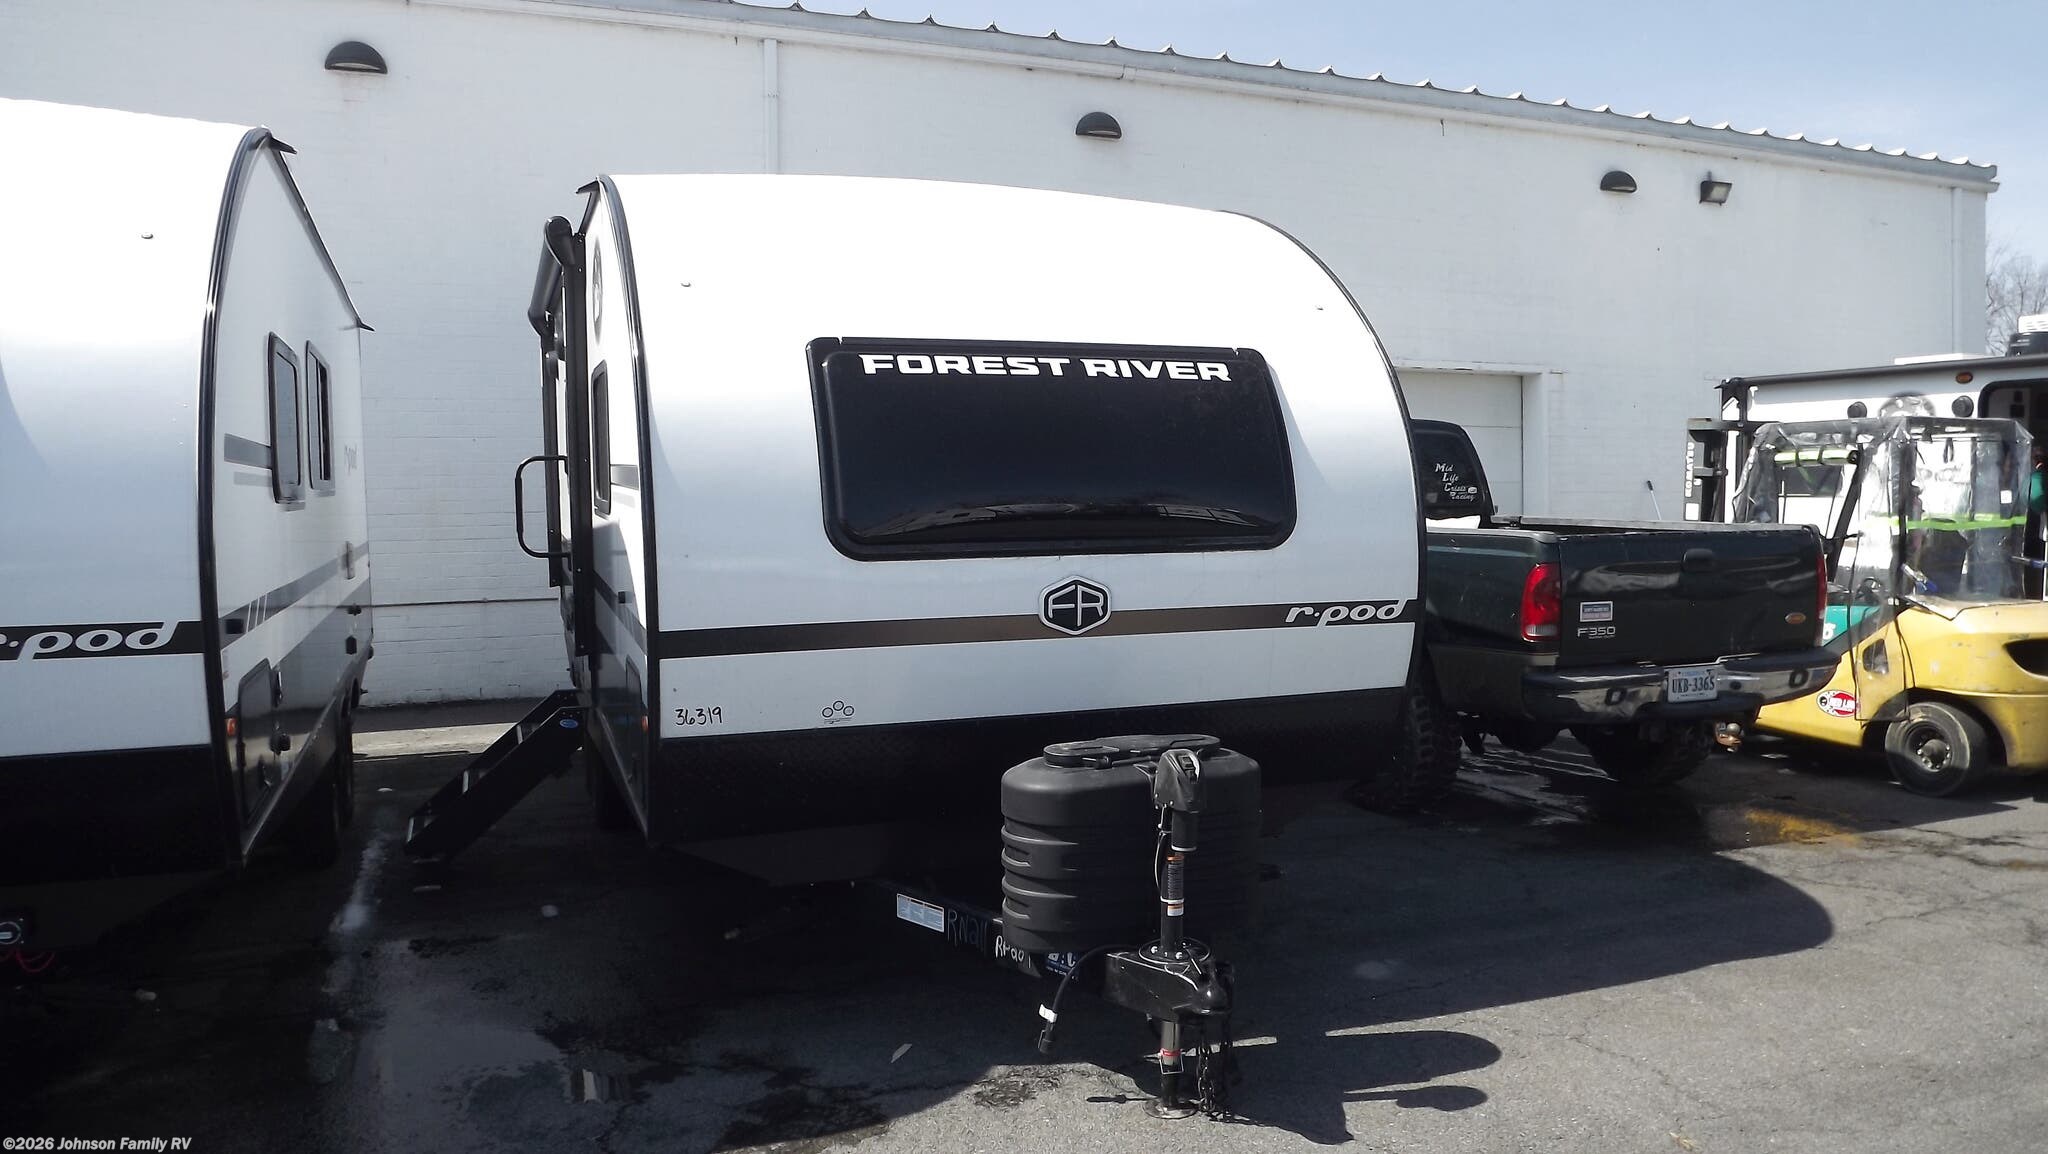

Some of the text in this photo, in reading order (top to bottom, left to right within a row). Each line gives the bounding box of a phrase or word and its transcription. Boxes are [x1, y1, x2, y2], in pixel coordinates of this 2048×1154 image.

[857, 353, 1233, 382] FOREST RIVER
[674, 706, 723, 726] 36319
